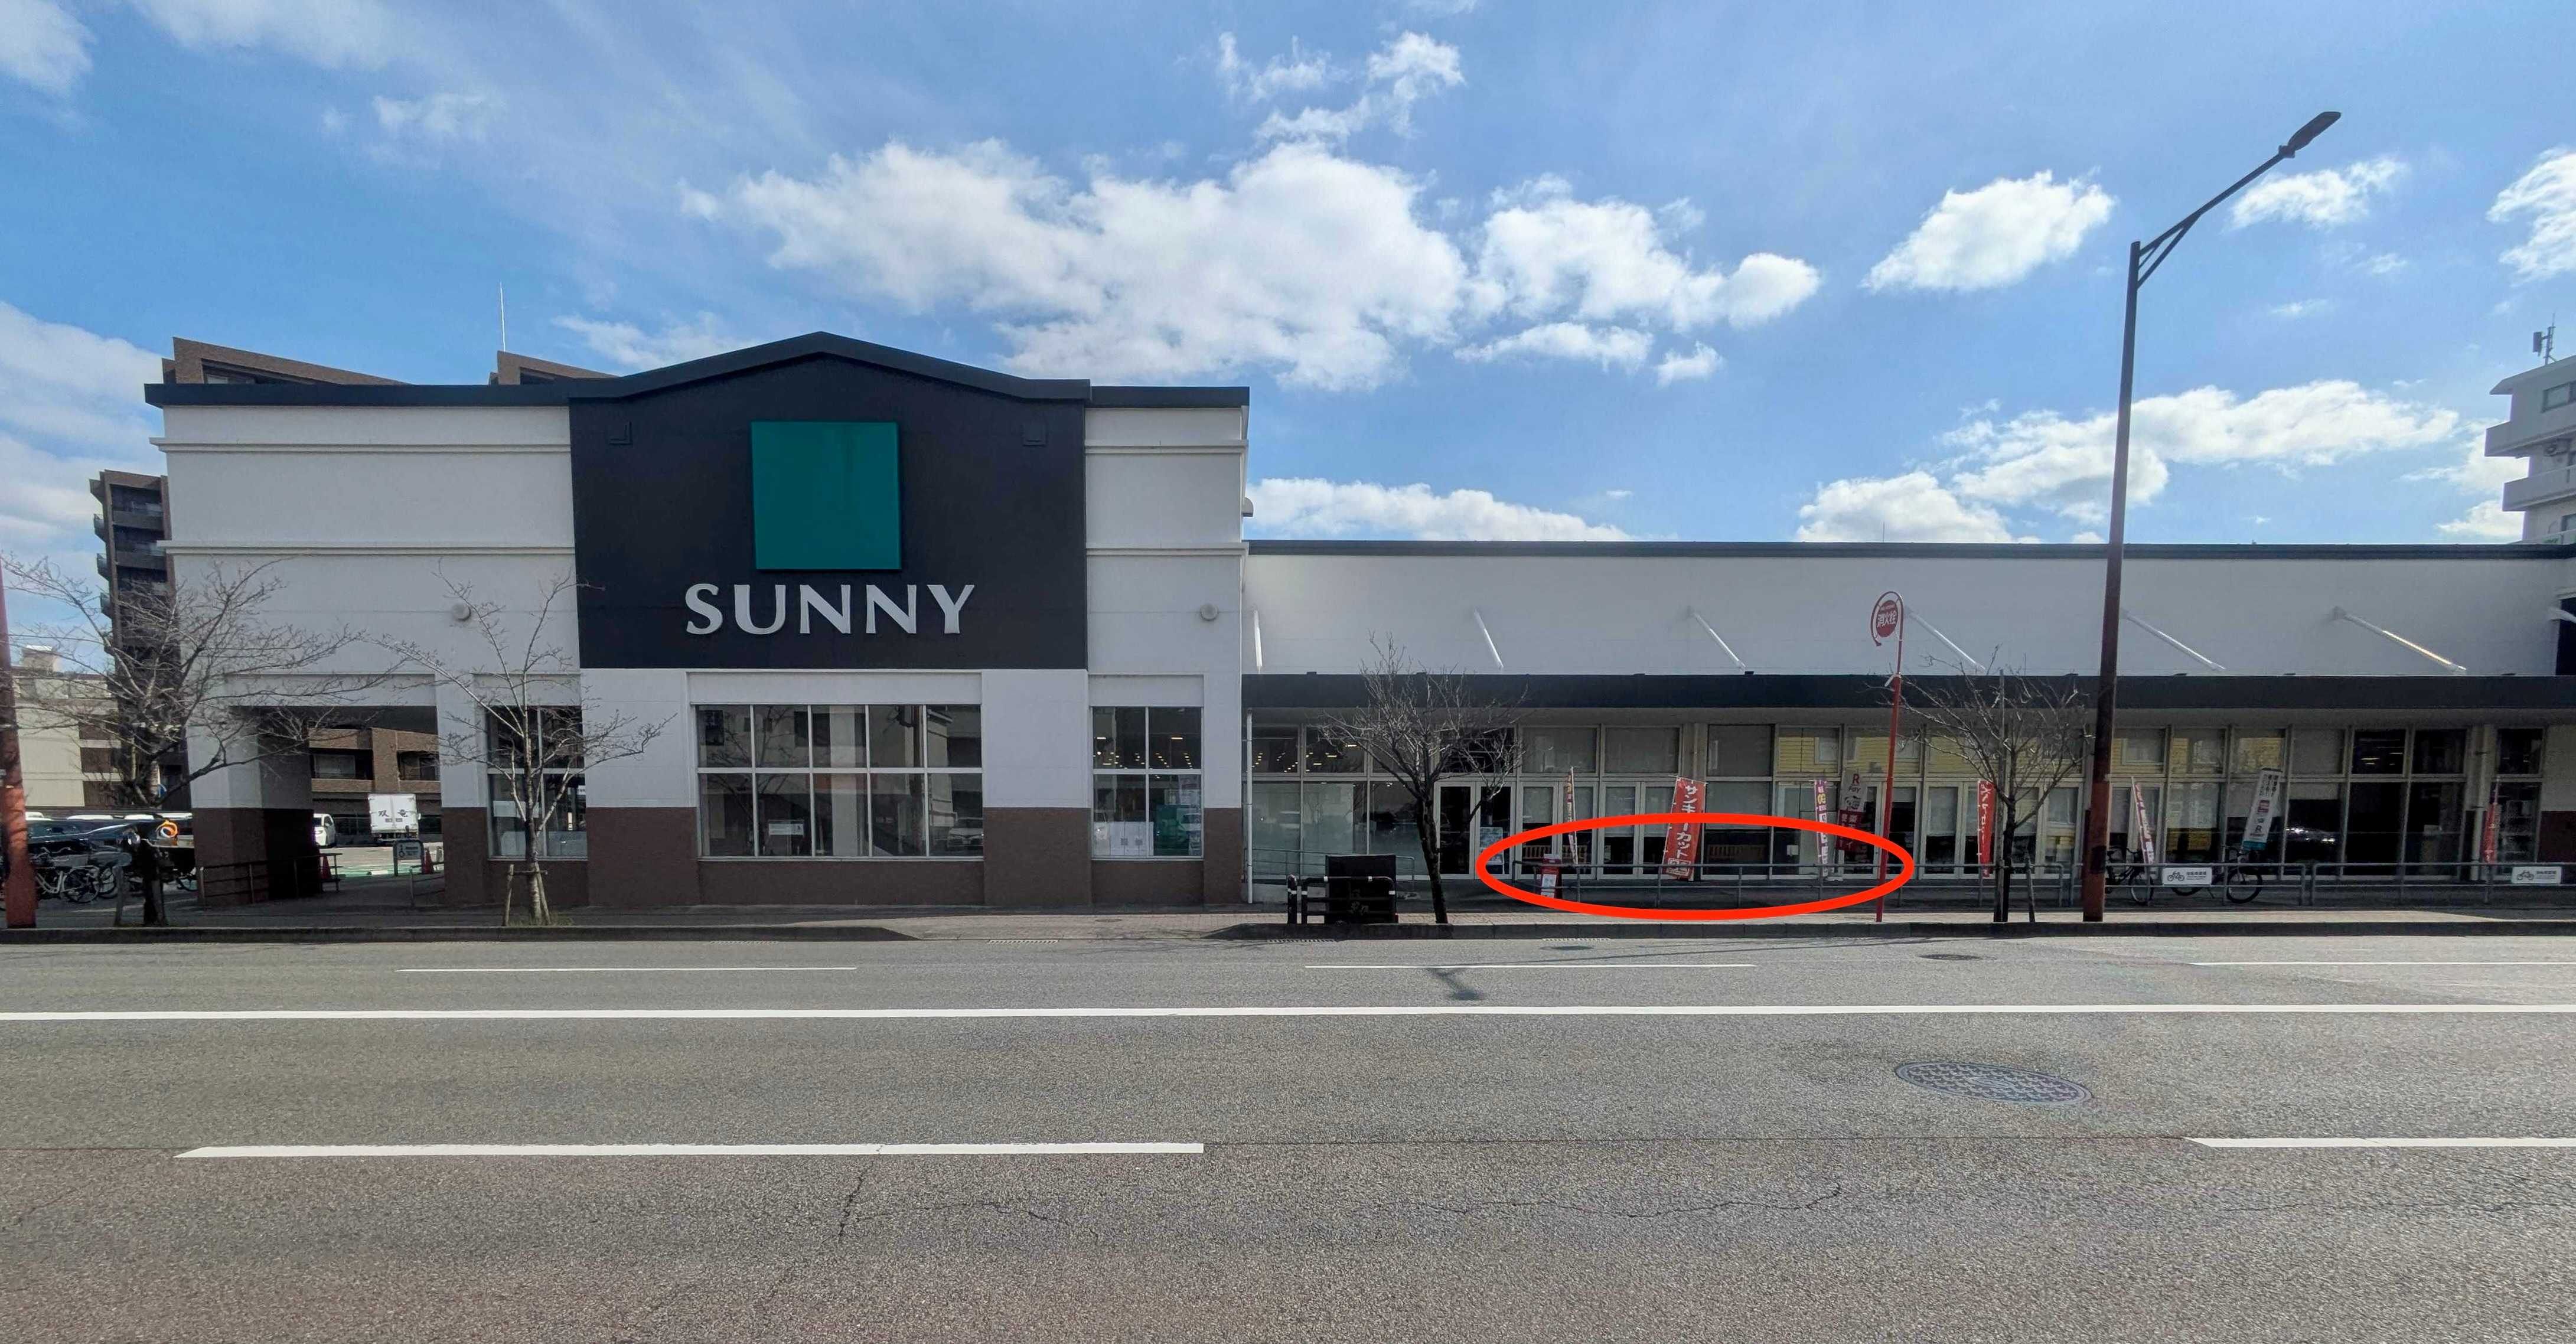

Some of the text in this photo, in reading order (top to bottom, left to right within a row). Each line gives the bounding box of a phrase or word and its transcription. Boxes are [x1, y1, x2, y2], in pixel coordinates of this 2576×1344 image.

[685, 583, 975, 635] SUNNY
[1877, 611, 1896, 627] 消火栓
[1853, 774, 1860, 785] R
[1677, 785, 1698, 859] サンキーカット
